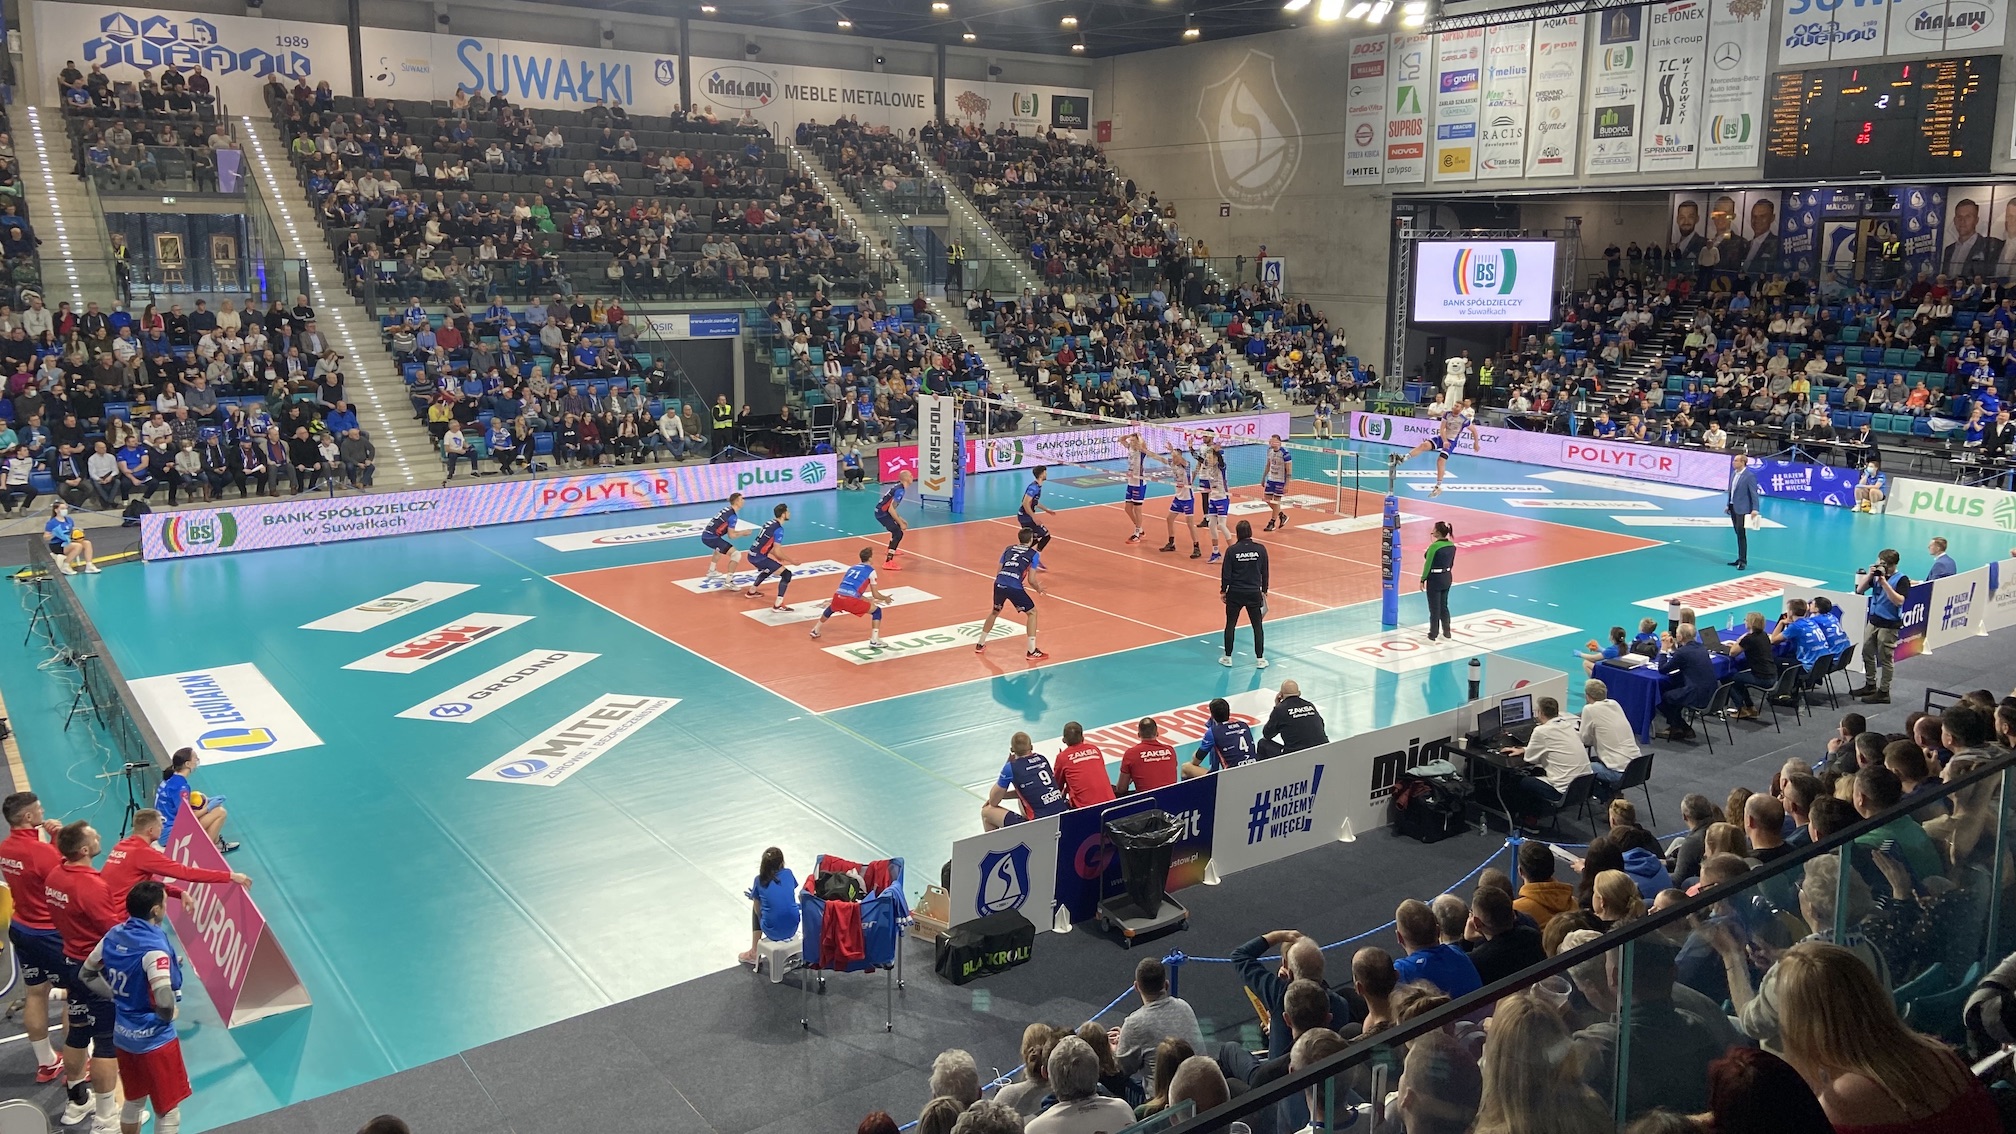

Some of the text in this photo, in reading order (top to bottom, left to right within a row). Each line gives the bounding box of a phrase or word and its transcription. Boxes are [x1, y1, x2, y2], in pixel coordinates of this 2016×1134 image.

[1654, 8, 1705, 24] BETONEX
[275, 35, 309, 48] 1989
[1353, 41, 1385, 55] BOSS
[1553, 41, 1577, 50] PDM
[1652, 35, 1703, 47] Link Group
[1495, 65, 1527, 77] melius
[1453, 72, 1476, 86] grafit
[785, 84, 925, 109] MEBLE METALOWE
[1678, 57, 1693, 124] WITKOWSKI
[1389, 118, 1423, 137] SUPROS
[1482, 127, 1523, 141] RACIS
[1600, 125, 1630, 134] BUDOPOL
[1391, 147, 1420, 156] NOVOL
[1644, 145, 1688, 153] SPRINKLER
[1352, 166, 1380, 176] MITEL
[1387, 164, 1413, 178] calypso
[1833, 195, 1849, 203] MKS
[1476, 262, 1495, 282] BS
[1443, 297, 1524, 307] BANK SPÓŁDZIELCZY
[1467, 307, 1507, 316] Suwałkach
[1373, 401, 1415, 417] 25 KMH
[1403, 424, 1429, 434] BANK
[929, 400, 942, 475] KRISPOL
[1036, 440, 1063, 451] BANK
[1567, 444, 1673, 471] POLYTOR
[737, 465, 793, 490] plus
[543, 478, 669, 505] POLYTOR
[1908, 487, 1985, 518] plus
[262, 499, 439, 527] BANK SPÓŁDZIELCZY
[302, 515, 407, 535] w Suwałkach
[188, 524, 211, 541] BS
[614, 523, 706, 542] MLEKPO
[1011, 553, 1020, 561] 2
[1235, 551, 1259, 560] ZAKSA
[847, 568, 861, 579] 71
[1813, 629, 1826, 642] 18
[466, 651, 570, 701] GRODNO
[1287, 705, 1315, 715] ZAKSA
[527, 698, 650, 758] MITEL
[1238, 735, 1250, 753] 4
[1068, 748, 1099, 761] ZAKSA
[1139, 748, 1172, 760] ZAKSA
[1038, 769, 1052, 786] 9
[1273, 779, 1309, 803] RAZEM
[1271, 794, 1314, 821] MOŻEMY
[1270, 815, 1306, 839] WIĘCEJ
[109, 849, 127, 859] AKSA
[108, 967, 130, 997] 22
